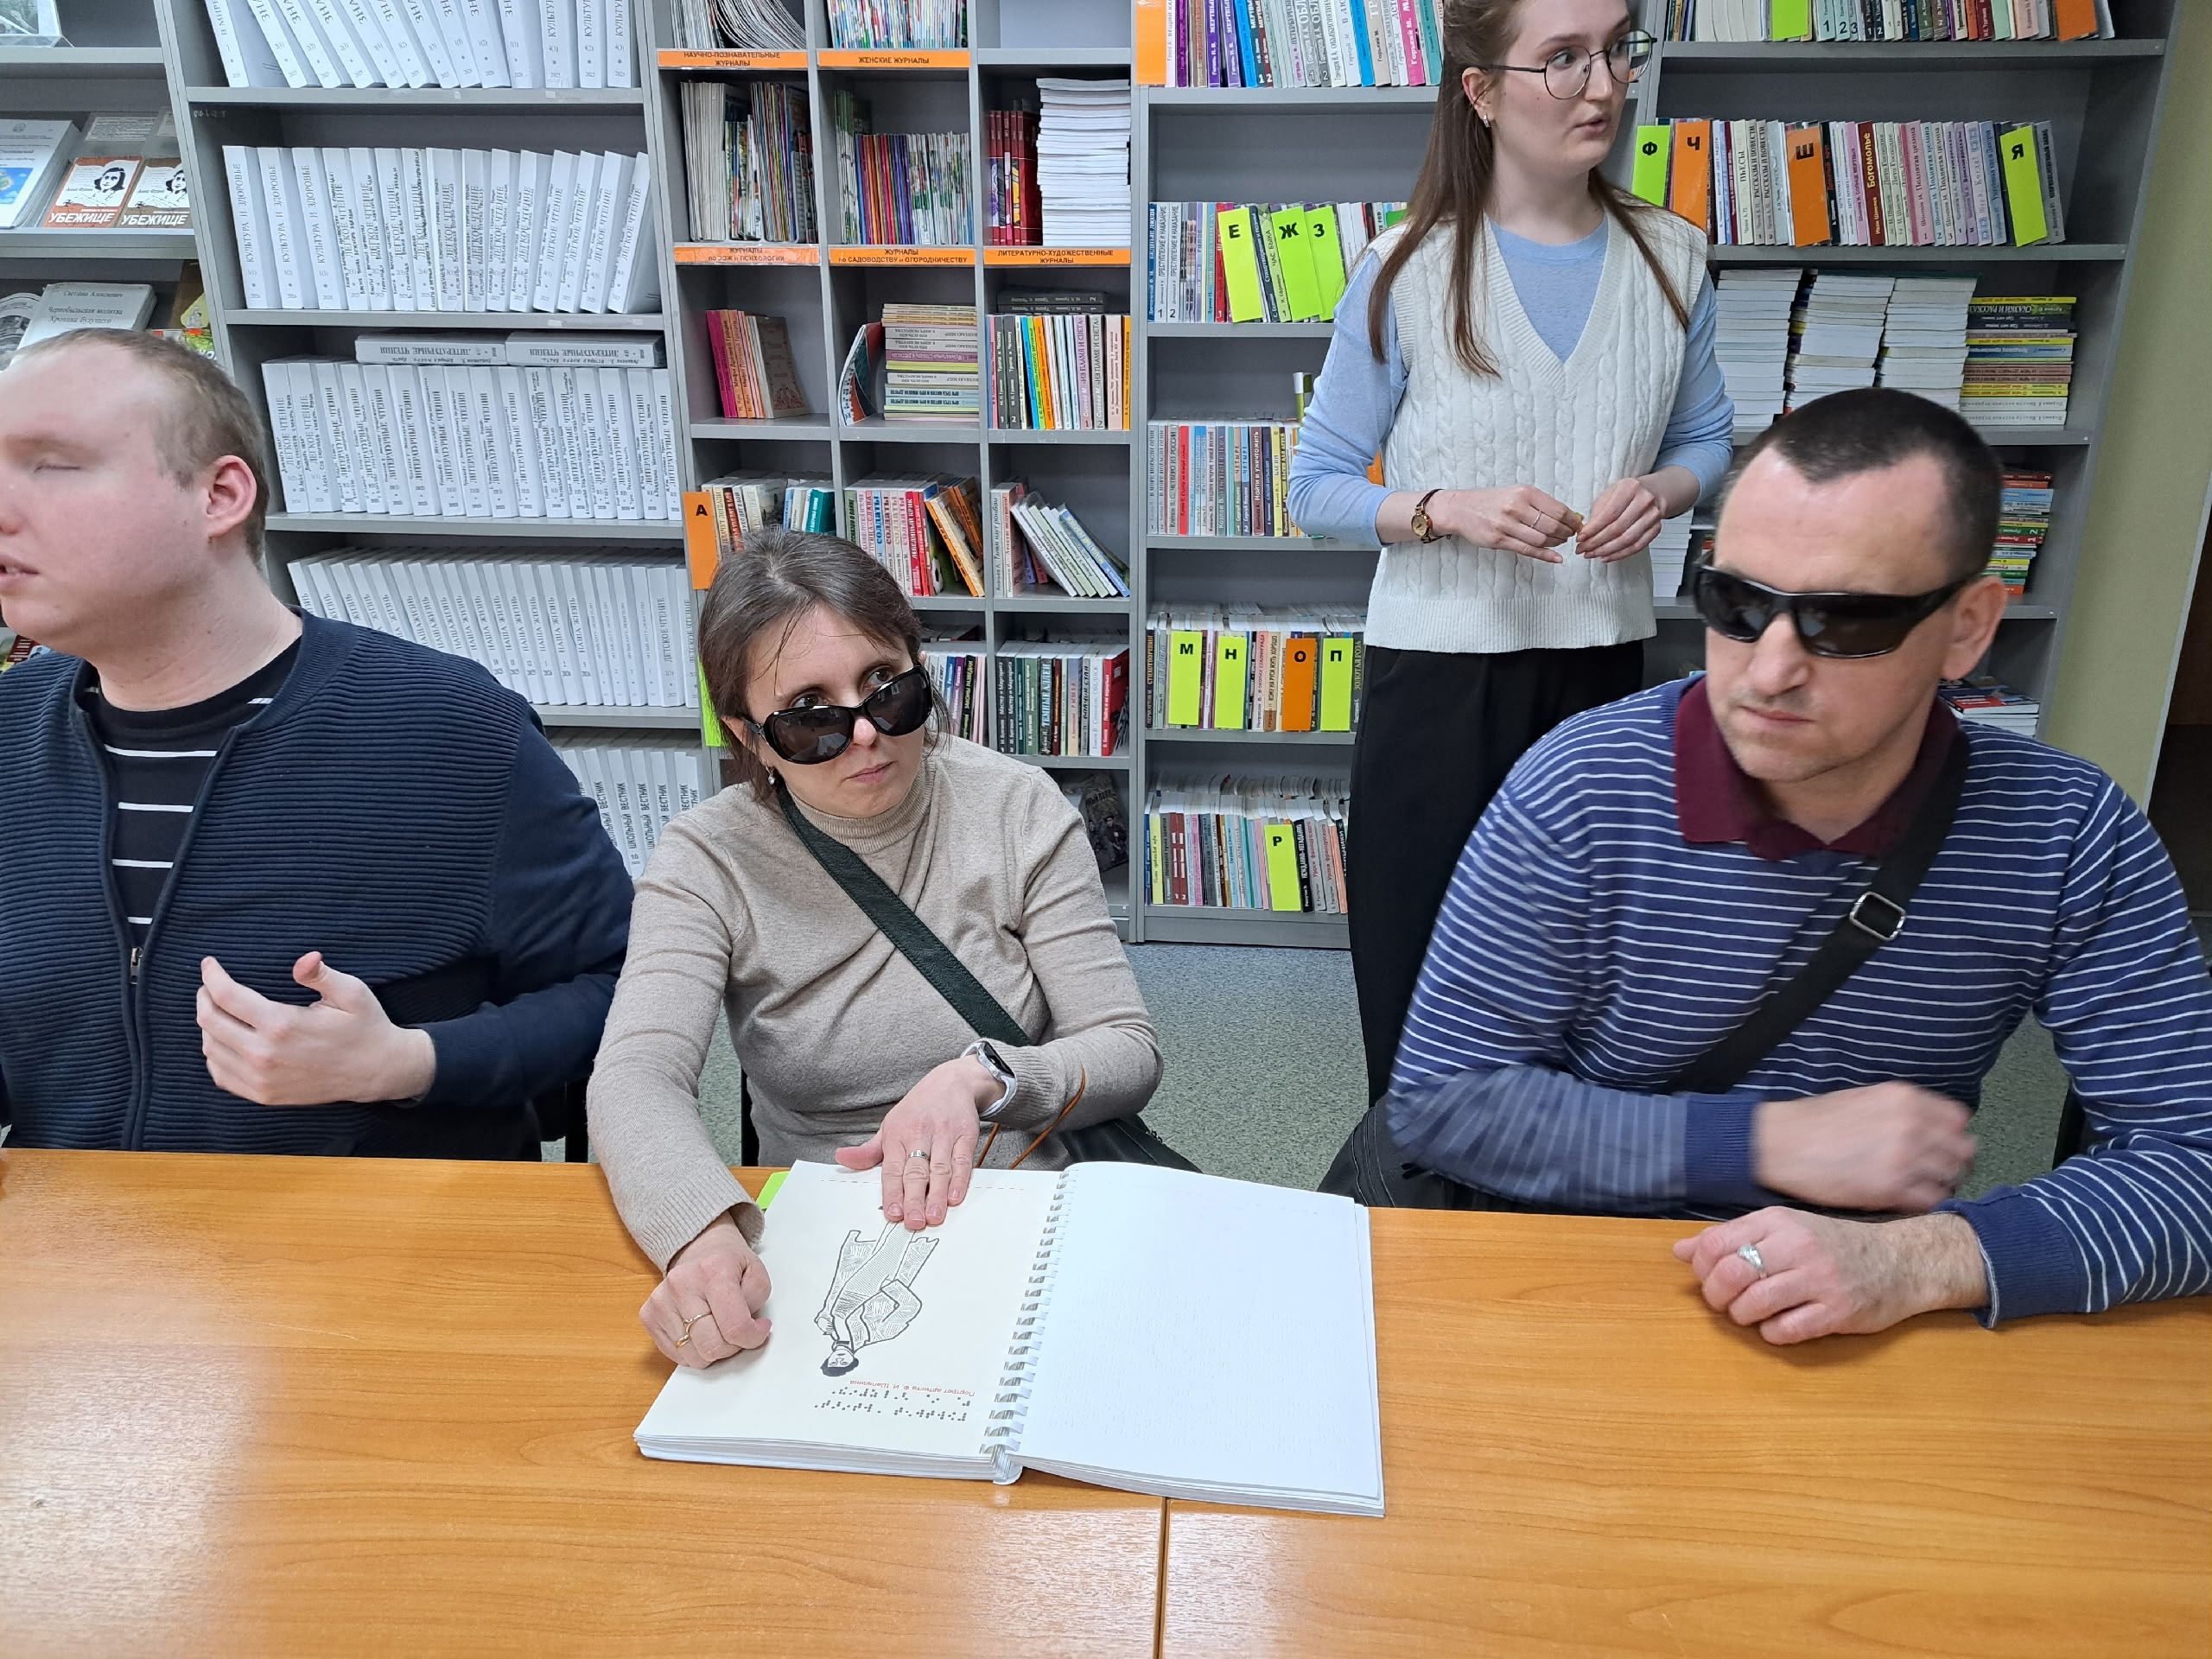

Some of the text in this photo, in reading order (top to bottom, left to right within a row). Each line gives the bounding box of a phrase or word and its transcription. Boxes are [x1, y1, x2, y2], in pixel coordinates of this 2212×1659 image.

[1823, 20, 1829, 32] 1
[1840, 22, 1847, 34] 2
[1851, 22, 1858, 34] 3
[1643, 142, 1657, 156] Ф
[1687, 137, 1700, 150] Ч
[1796, 143, 1814, 160] Ш
[2012, 143, 2024, 161] Я
[1864, 132, 1876, 188] Богомолье
[232, 163, 246, 207] ЗДОРОВЬЕ
[269, 164, 282, 207] ЗДОРОВЬЕ
[301, 166, 316, 207] ЗДОРОВЬЕ
[48, 213, 115, 224] УБЕЖИЩЕ
[121, 215, 188, 226] УБЕЖИЩЕ
[1229, 224, 1240, 238] Е
[1279, 222, 1299, 239] Ж
[241, 222, 255, 263] КУЛЬТУРА
[277, 222, 290, 263] КУЛЬТУРА
[312, 223, 325, 264] КУЛЬТУРА
[696, 504, 708, 516] А
[874, 496, 882, 543] СОЛДАТЫ
[883, 496, 892, 544] СОЛДАТЫ
[1180, 644, 1193, 655] М
[1225, 649, 1236, 660] Н
[1331, 651, 1342, 662] П
[637, 784, 650, 810] ВЕСТНИК
[658, 785, 669, 811] ВЕСТНИК
[616, 782, 636, 849] ШКОЛЬНЫЙ ВЕСТНИК
[850, 1380, 889, 1389] Шаляпина
[944, 1389, 976, 1397] Портрет
